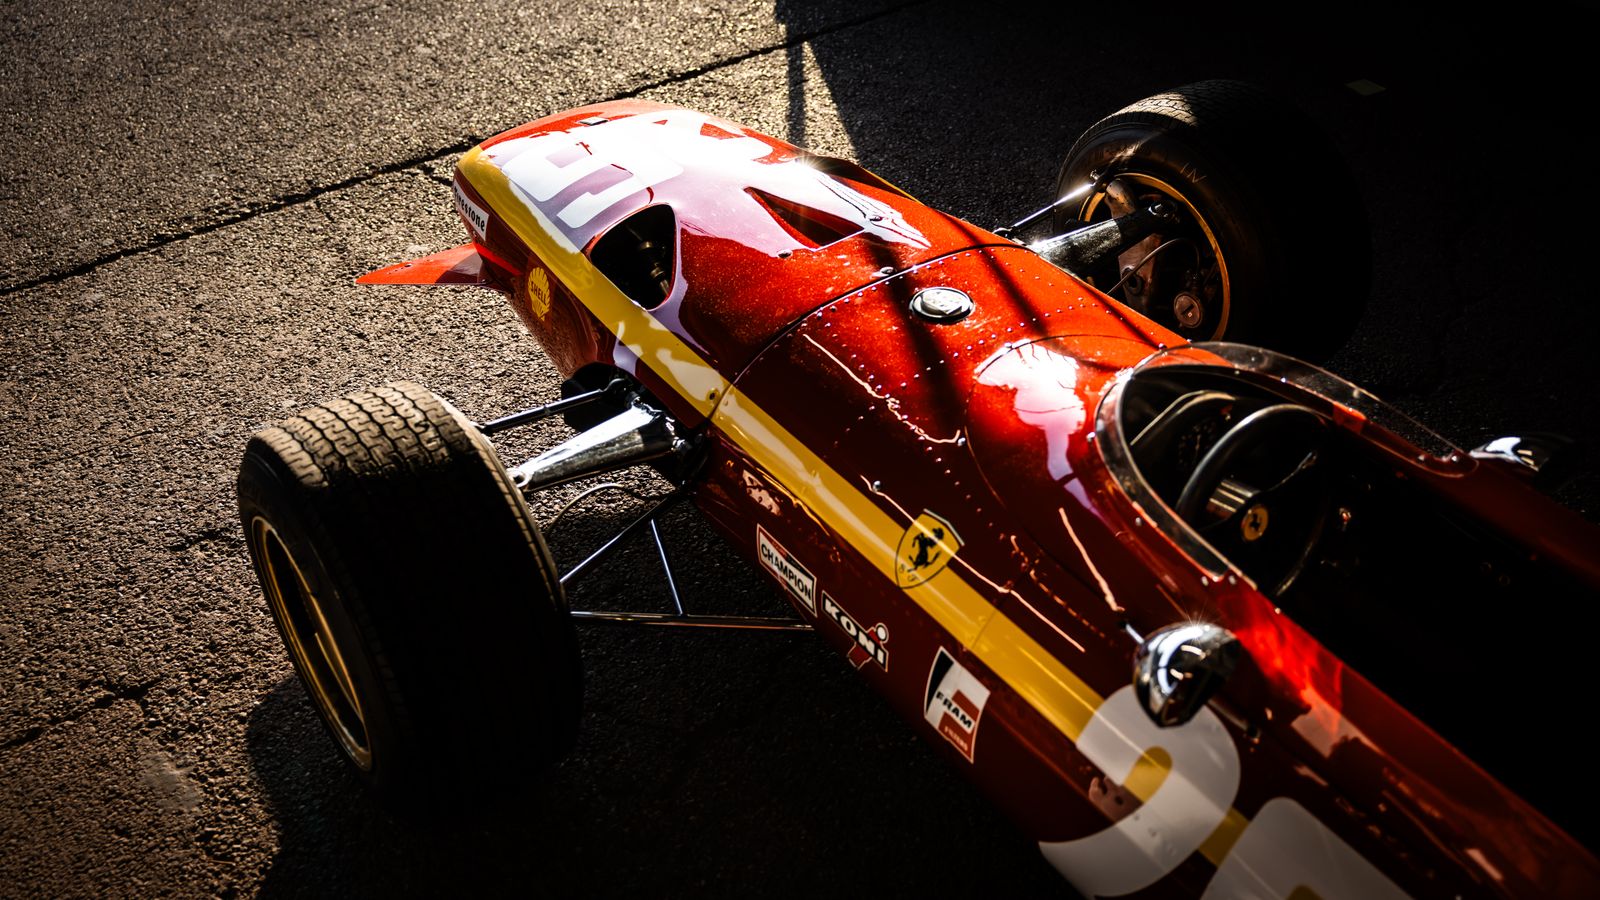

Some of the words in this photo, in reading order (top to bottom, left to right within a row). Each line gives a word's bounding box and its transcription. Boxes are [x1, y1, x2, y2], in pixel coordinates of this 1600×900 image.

[530, 284, 548, 306] SHELL
[760, 543, 812, 600] CHAMPION
[824, 598, 885, 665] KONI
[936, 691, 973, 729] FRAM
